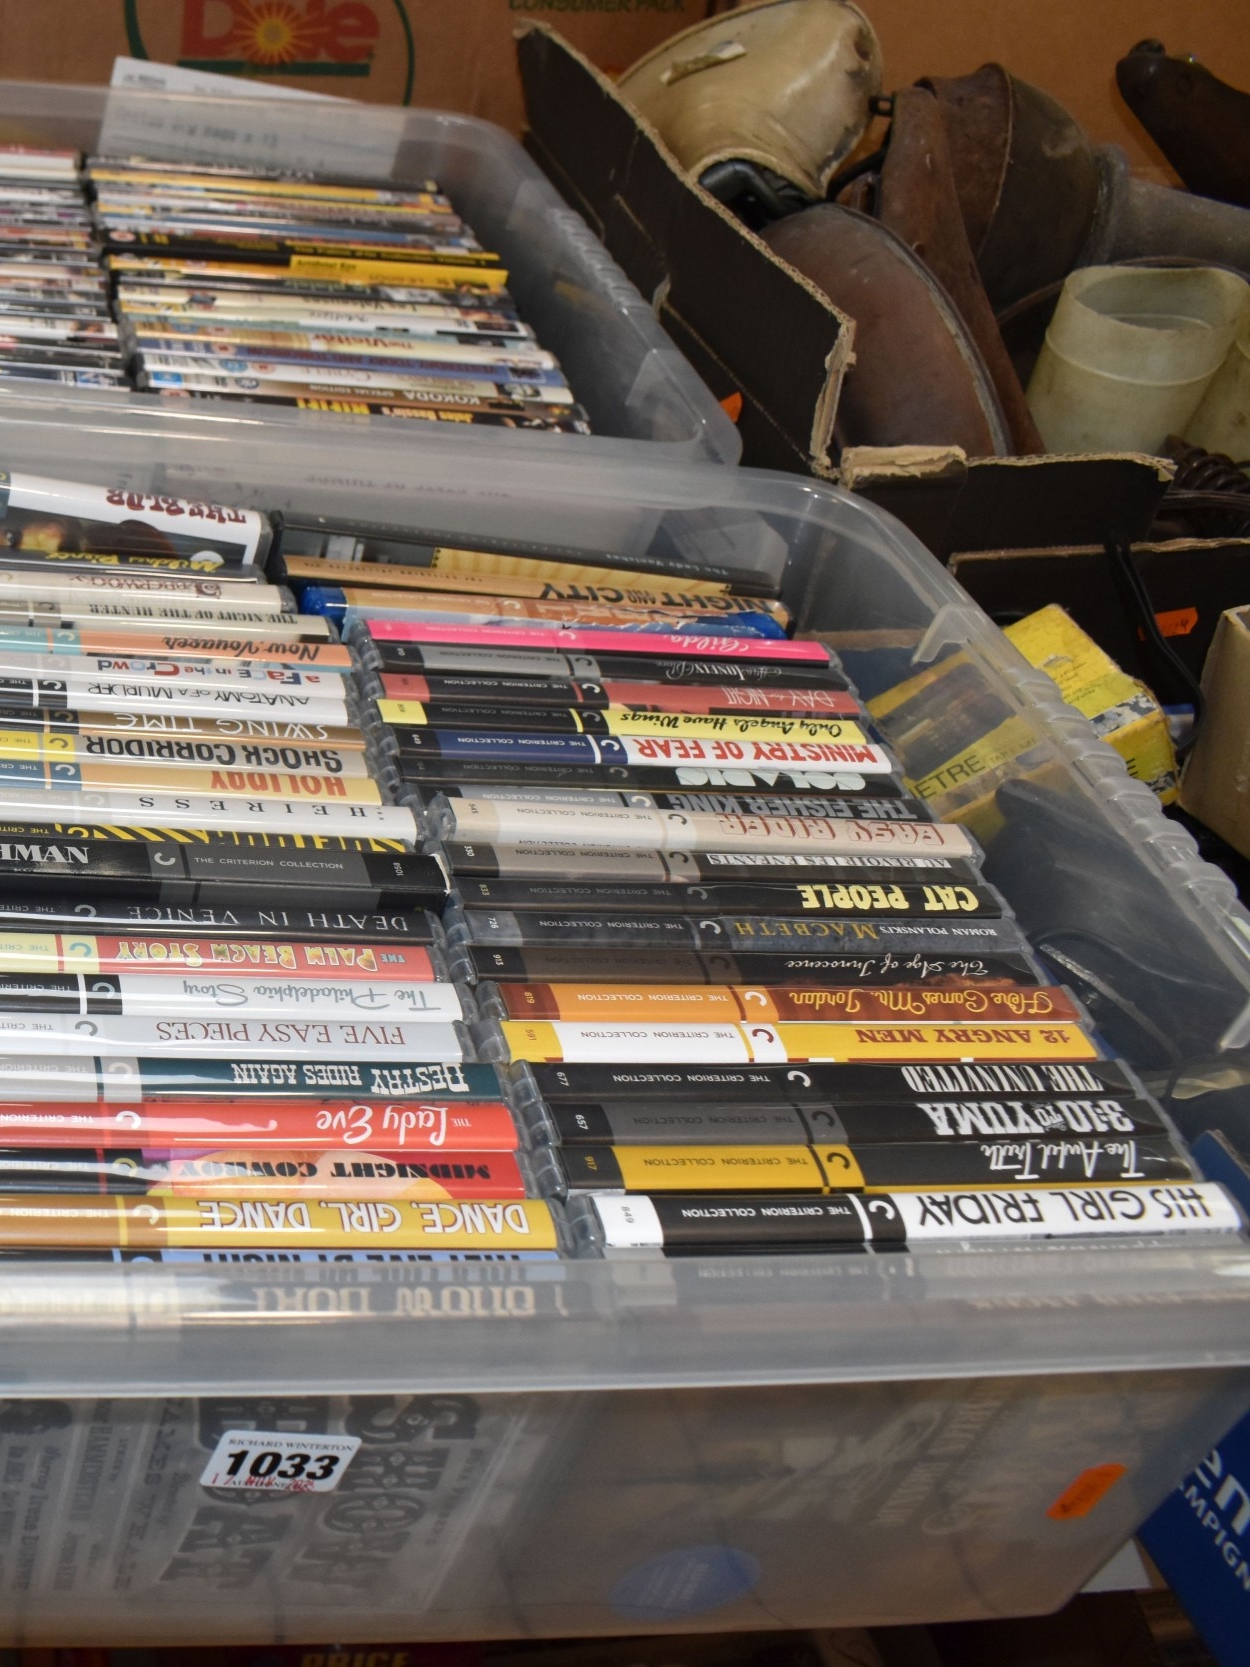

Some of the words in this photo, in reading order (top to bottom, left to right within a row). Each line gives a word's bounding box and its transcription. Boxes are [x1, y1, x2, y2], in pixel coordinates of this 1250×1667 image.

[113, 712, 202, 733] TIME
[215, 718, 329, 740] SWING
[621, 712, 679, 728] Wings
[683, 714, 727, 730] Have
[734, 718, 794, 735] Angels
[799, 720, 842, 738] Only
[633, 738, 707, 759] FEAR
[711, 740, 743, 760] OF
[752, 742, 878, 763] MINISTRY
[211, 770, 347, 796] HOLIDAY
[913, 755, 987, 800] ETRE
[669, 794, 744, 814] KING
[750, 796, 851, 818] FISHER
[861, 799, 918, 820] THE
[715, 813, 836, 841] RIDER
[849, 821, 945, 846] EASY
[798, 884, 906, 910] PEOPLE
[924, 885, 979, 912] CAT
[127, 906, 240, 925] VENICE
[259, 911, 289, 927] IN
[308, 913, 408, 931] DEATH
[734, 921, 880, 940] MACBETH
[880, 924, 949, 937] POLANSKI'S
[953, 927, 997, 937] ROMAN
[118, 941, 203, 967] STORY
[211, 944, 298, 970] BEACH
[305, 946, 378, 972] PALM
[380, 953, 405, 964] THE
[880, 953, 899, 971] of
[785, 959, 876, 977] Innocence
[903, 953, 945, 978] Age
[951, 959, 989, 977] The
[183, 980, 249, 1006] Story
[253, 984, 390, 1010] Philadelphia
[394, 989, 441, 1011] The
[789, 989, 861, 1013] Jordan
[870, 990, 926, 1015] Mr.
[922, 990, 989, 1012] Comes
[990, 990, 1053, 1015] Here
[156, 1021, 249, 1042] PIECES
[257, 1024, 332, 1043] EASY
[339, 1025, 406, 1045] FIVE
[855, 1028, 922, 1043] MEN
[932, 1028, 1032, 1044] ANGRY
[1039, 1029, 1071, 1044] 12
[231, 1063, 297, 1085] AGAIN
[305, 1065, 362, 1086] RIDES
[371, 1063, 470, 1095] DESTRY
[557, 1072, 569, 1087] 677
[901, 1065, 1044, 1092] UNINVITED
[1039, 1065, 1104, 1092] THE
[317, 1106, 374, 1144] Eve
[383, 1106, 448, 1146] Lady
[451, 1118, 471, 1127] THE
[575, 1114, 589, 1130] 657
[916, 1101, 1042, 1135] YUMA
[1033, 1104, 1062, 1128] TO
[1058, 1100, 1136, 1133] 3:10
[330, 1161, 491, 1180] MIDNIGHT
[980, 1141, 1040, 1180] Truth
[1103, 1140, 1145, 1179] The
[682, 1208, 755, 1218] COLLECTION
[762, 1207, 823, 1216] CRITERION
[827, 1206, 851, 1215] THE
[915, 1192, 1045, 1227] FRIDAY
[1049, 1190, 1146, 1221] GIRL
[1149, 1187, 1211, 1219] HIS
[200, 1199, 311, 1232] DANCE
[318, 1201, 402, 1234] GIRL,
[411, 1202, 530, 1235] DANCE,
[622, 1206, 635, 1224] 849
[228, 1438, 284, 1448] RICHARD
[286, 1441, 355, 1452] WINTERTON
[225, 1449, 340, 1480] 1033
